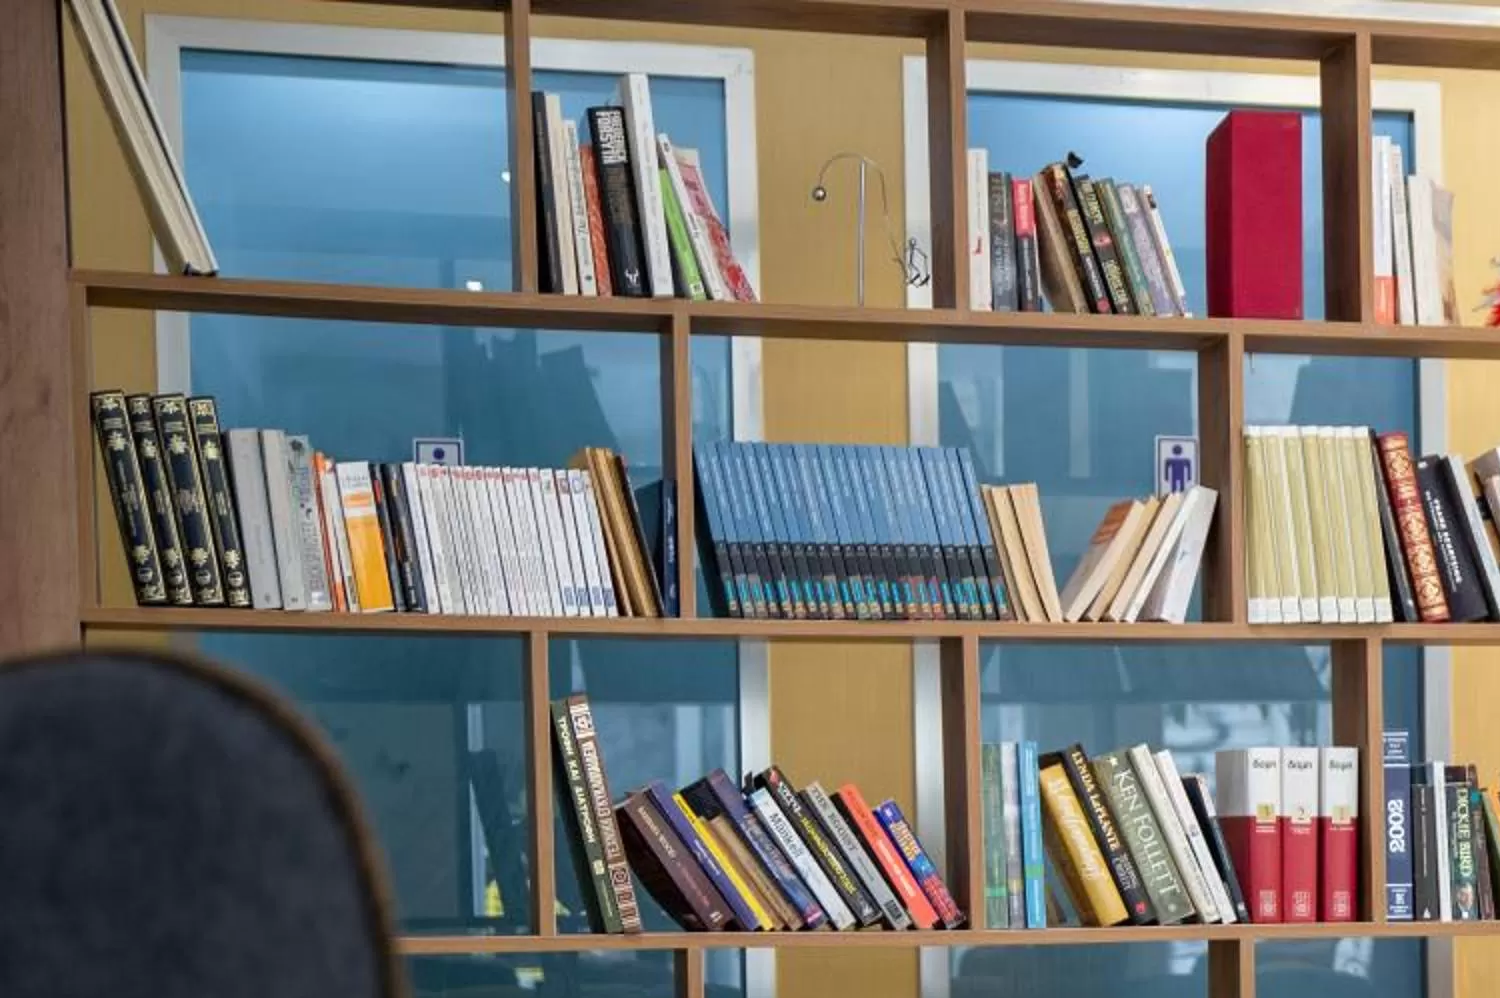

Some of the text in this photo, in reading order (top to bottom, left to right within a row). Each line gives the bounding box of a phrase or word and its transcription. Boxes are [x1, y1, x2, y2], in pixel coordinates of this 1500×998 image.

[595, 110, 616, 165] FORSYTH
[1114, 768, 1181, 895] KEN FOLLETT
[1455, 785, 1471, 840] DICKIE
[1459, 841, 1474, 877] BIRD
